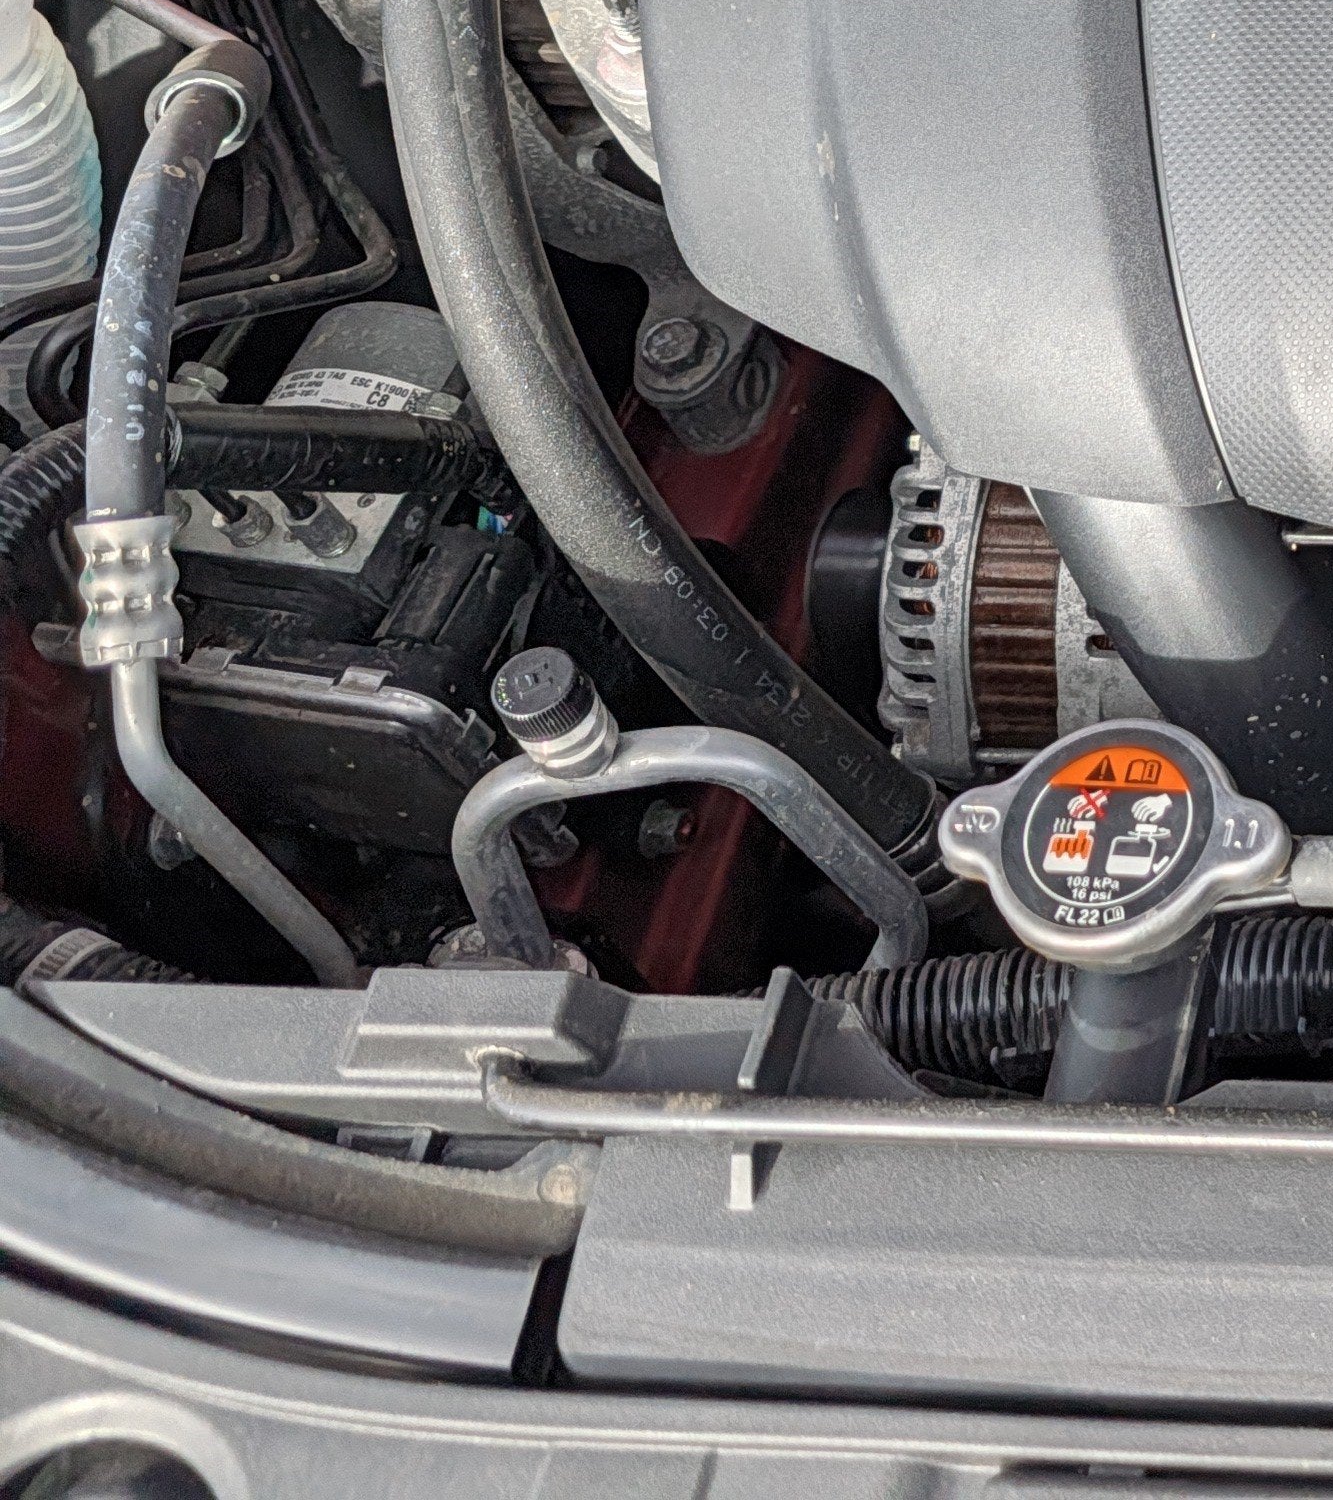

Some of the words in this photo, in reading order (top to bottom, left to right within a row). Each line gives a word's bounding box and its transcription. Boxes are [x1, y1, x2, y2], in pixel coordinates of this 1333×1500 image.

[350, 376, 373, 388] ESC
[375, 381, 410, 399] K1900
[366, 391, 391, 408] C8
[664, 565, 730, 643] 03:09
[1221, 817, 1260, 850] 1.1
[1066, 875, 1091, 891] 108
[1093, 876, 1121, 892] kPa
[1071, 888, 1087, 901] 16
[1089, 888, 1113, 904] psi
[1053, 905, 1101, 926] FL22
